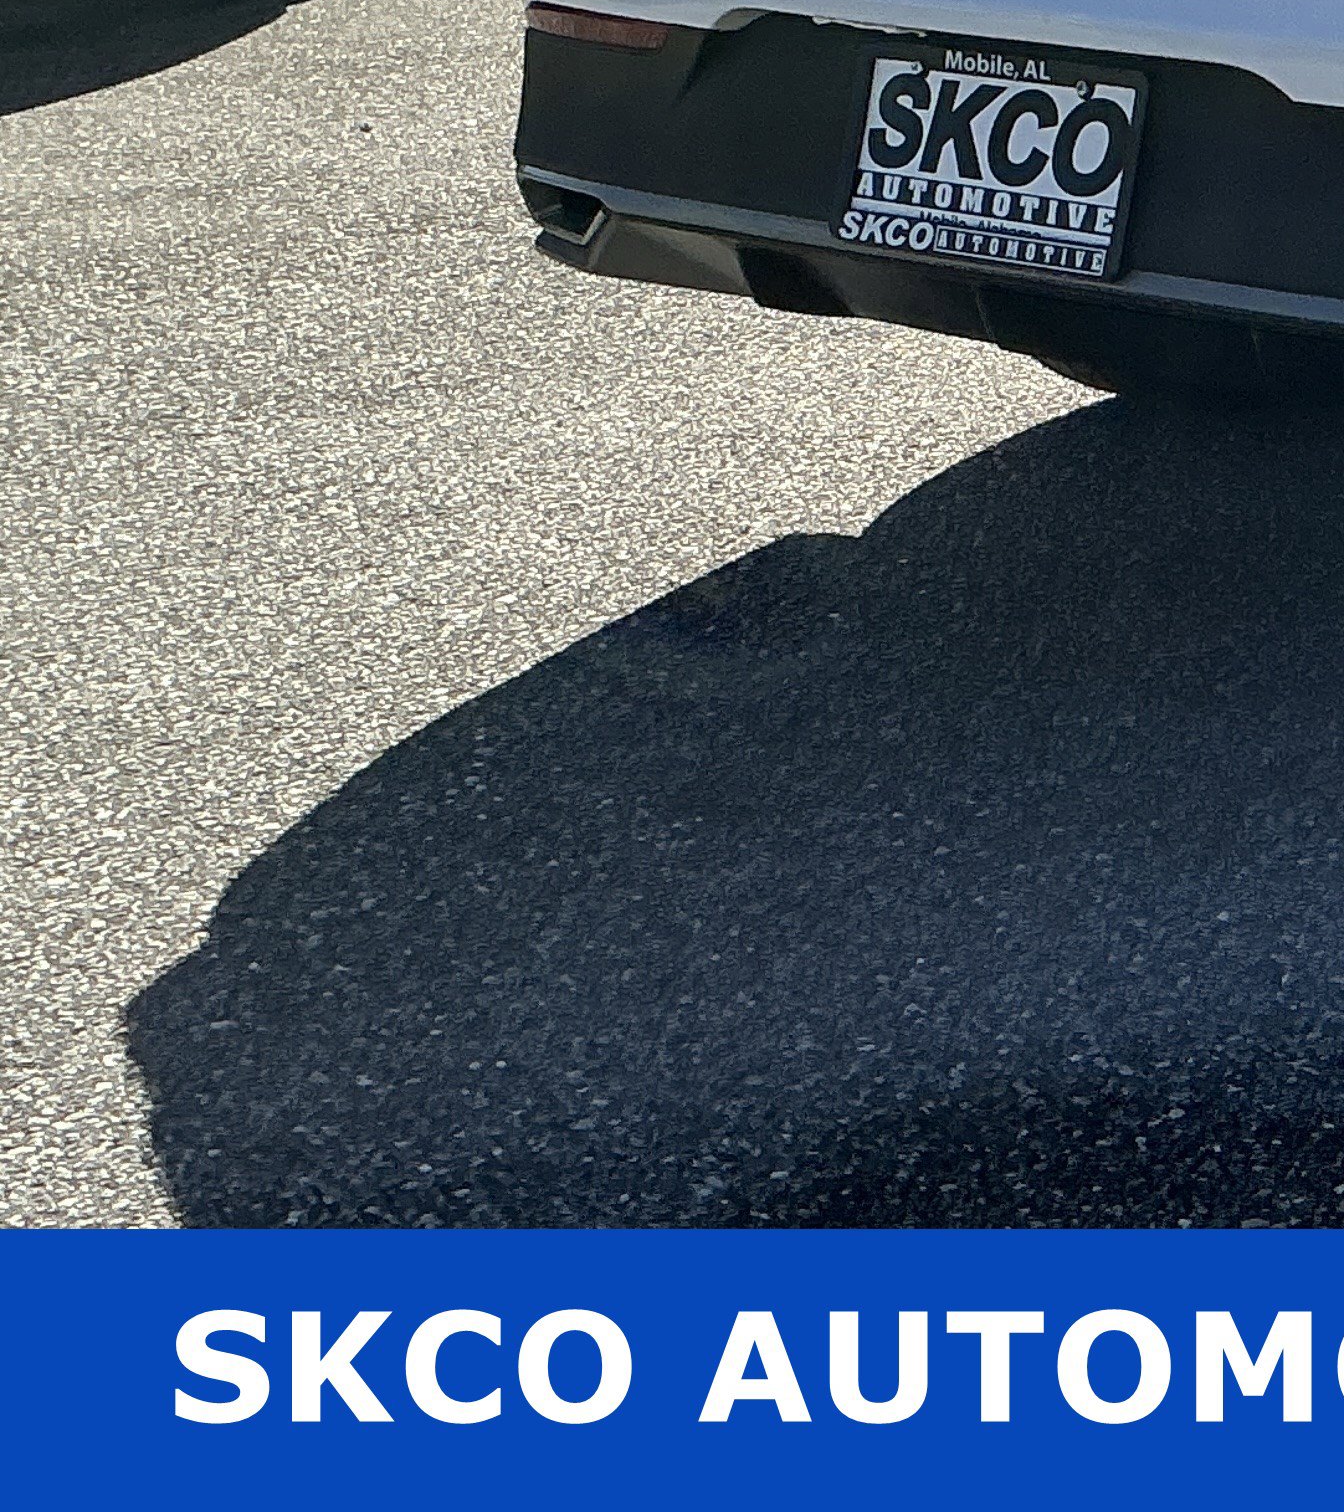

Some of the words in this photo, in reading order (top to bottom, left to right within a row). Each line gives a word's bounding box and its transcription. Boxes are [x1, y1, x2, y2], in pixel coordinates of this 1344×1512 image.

[944, 49, 1019, 81] Mobile,
[1022, 58, 1052, 82] AL
[867, 71, 1134, 198] SKCO
[856, 172, 1116, 235] AUTOMOTIVE
[837, 209, 935, 252] SKCO
[937, 229, 1105, 272] AUTOMOTIVE
